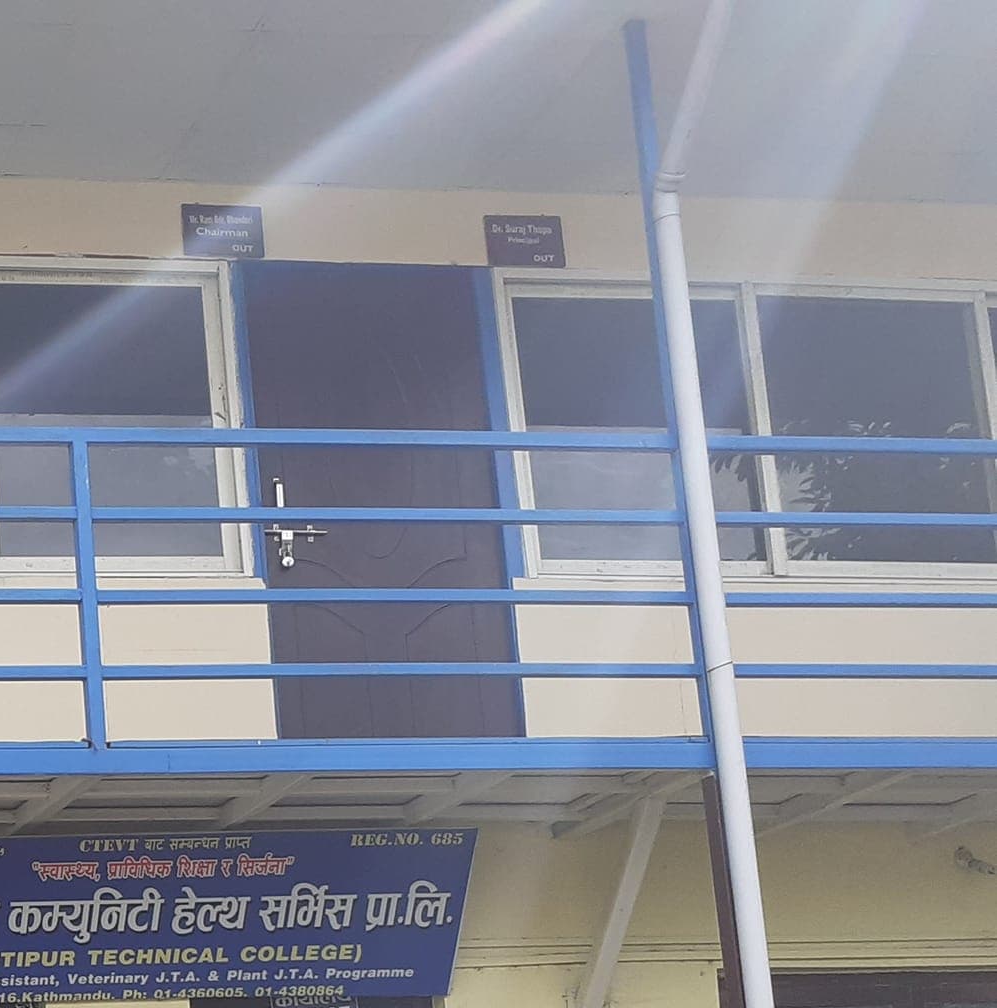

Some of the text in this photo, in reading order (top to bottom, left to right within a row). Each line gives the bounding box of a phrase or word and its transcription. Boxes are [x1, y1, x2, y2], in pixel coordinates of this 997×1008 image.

[195, 226, 249, 238] Chairman
[491, 223, 503, 233] Dr.
[232, 244, 254, 253] OUT
[533, 254, 555, 262] OUT
[79, 838, 138, 852] CTEVT
[350, 832, 464, 847] REG.NO. 685
[107, 856, 173, 881] प्राविधिक
[176, 854, 217, 879] शिक्षा
[220, 858, 234, 878] र
[7, 887, 165, 944] कम्युनिटी
[171, 886, 251, 935] हेल्थ
[258, 882, 357, 932] सर्भिस
[365, 880, 453, 932] प्रा.लि.
[87, 947, 230, 966] TECHNICAL
[240, 944, 362, 964] COLLEGE)
[67, 973, 149, 987] Veterinary
[155, 971, 201, 983] J.T.A.
[207, 970, 220, 982] &
[226, 970, 268, 982] Plant
[274, 968, 319, 980] J.T.A.
[325, 967, 414, 981] Programme
[122, 988, 148, 1001] Ph:
[254, 985, 345, 998] 01-4380864
